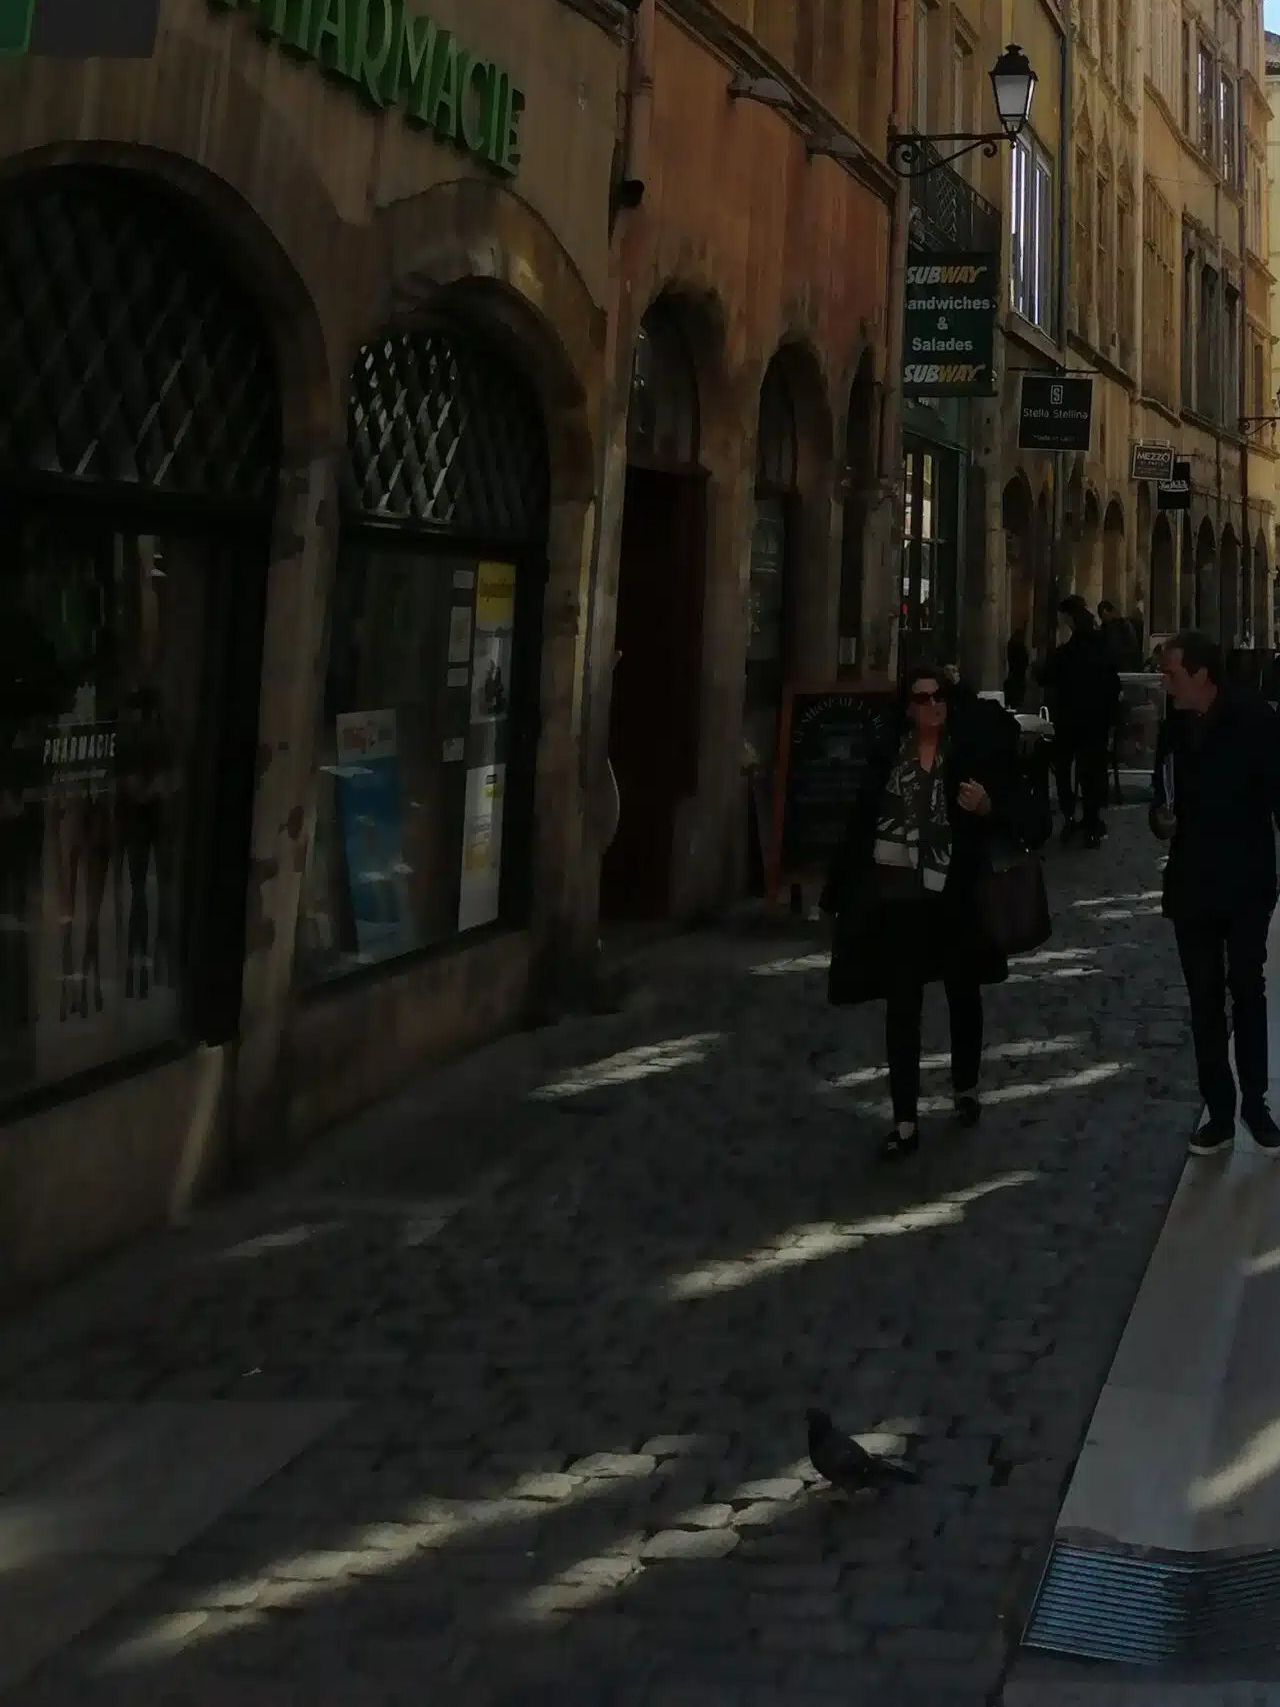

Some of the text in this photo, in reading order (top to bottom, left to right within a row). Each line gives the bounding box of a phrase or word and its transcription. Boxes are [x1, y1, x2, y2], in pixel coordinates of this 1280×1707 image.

[906, 265, 988, 286] SUBWAY
[905, 296, 990, 311] andwiches
[936, 316, 949, 331] &
[911, 336, 974, 353] Salades
[904, 362, 987, 384] SUBWAY
[1023, 407, 1050, 418] Stella
[1136, 451, 1171, 463] MEZZO
[43, 732, 117, 767] PHARMACIE
